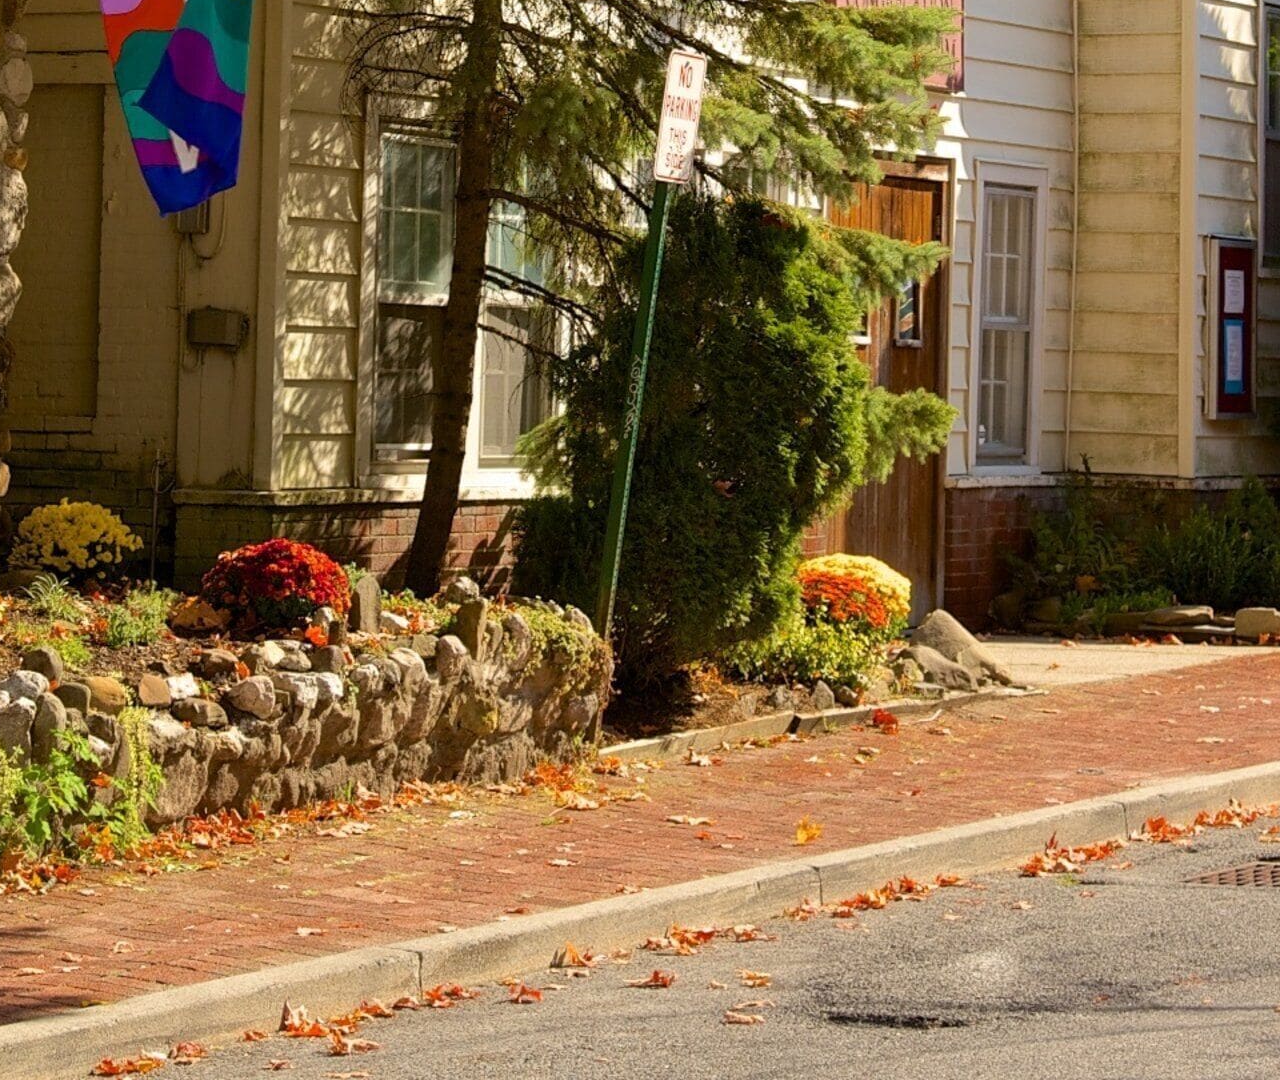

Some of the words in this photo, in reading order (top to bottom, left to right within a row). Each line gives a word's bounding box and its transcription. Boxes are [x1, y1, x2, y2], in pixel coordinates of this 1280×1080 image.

[679, 64, 693, 88] NO
[664, 94, 698, 122] PARKING
[669, 127, 687, 145] THIS
